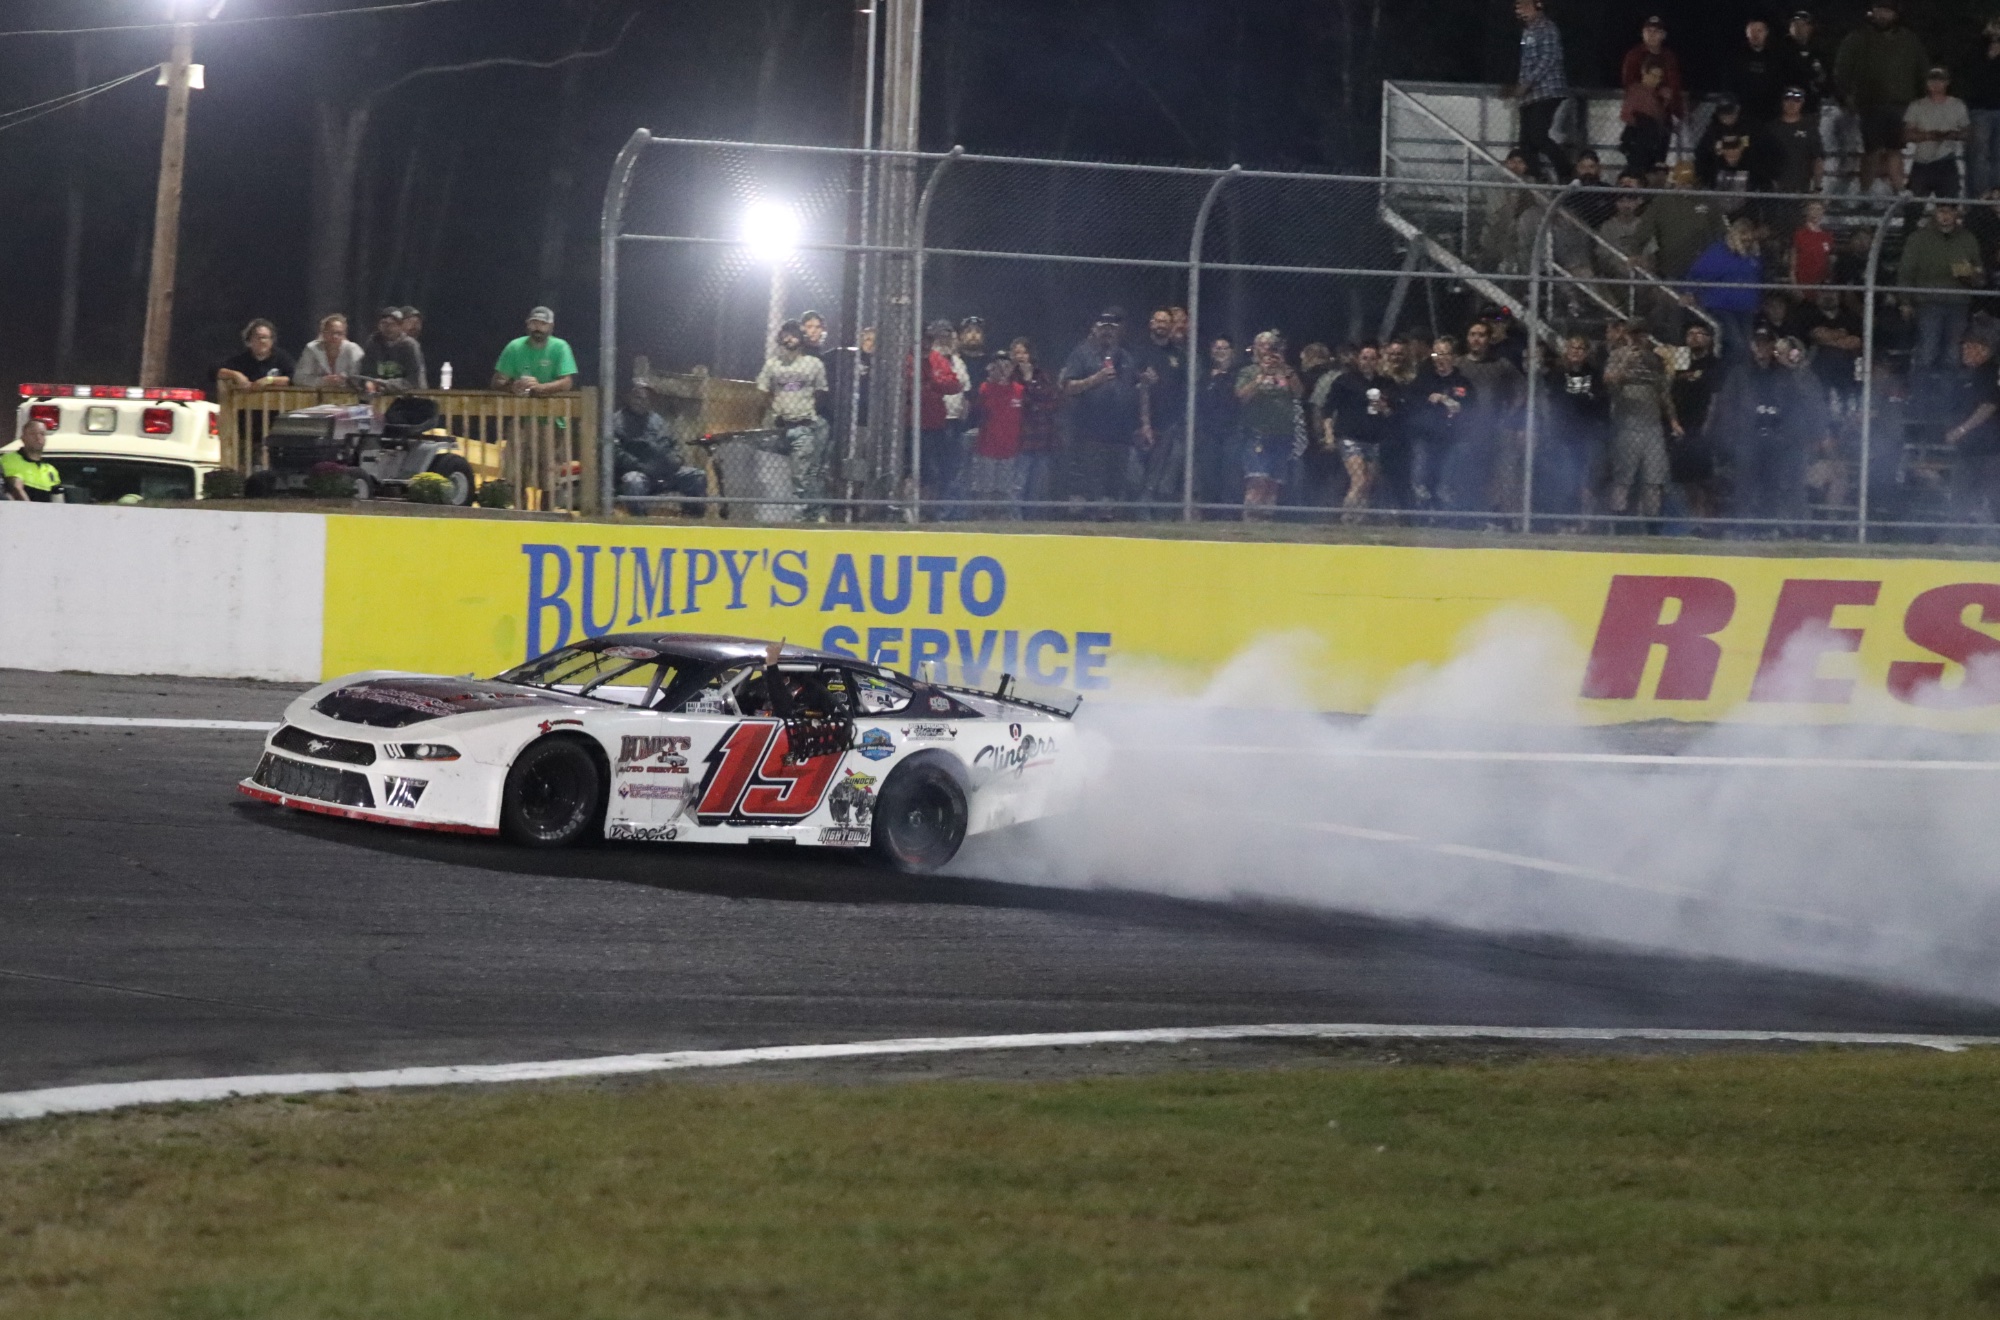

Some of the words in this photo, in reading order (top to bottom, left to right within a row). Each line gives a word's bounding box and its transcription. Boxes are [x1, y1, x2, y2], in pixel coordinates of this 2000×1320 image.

[521, 543, 809, 663] BUMPY'S
[819, 553, 1006, 617] AUTO
[618, 735, 692, 762] BUMPY'S
[695, 719, 848, 820] 19
[843, 776, 877, 786] SUNOCO
